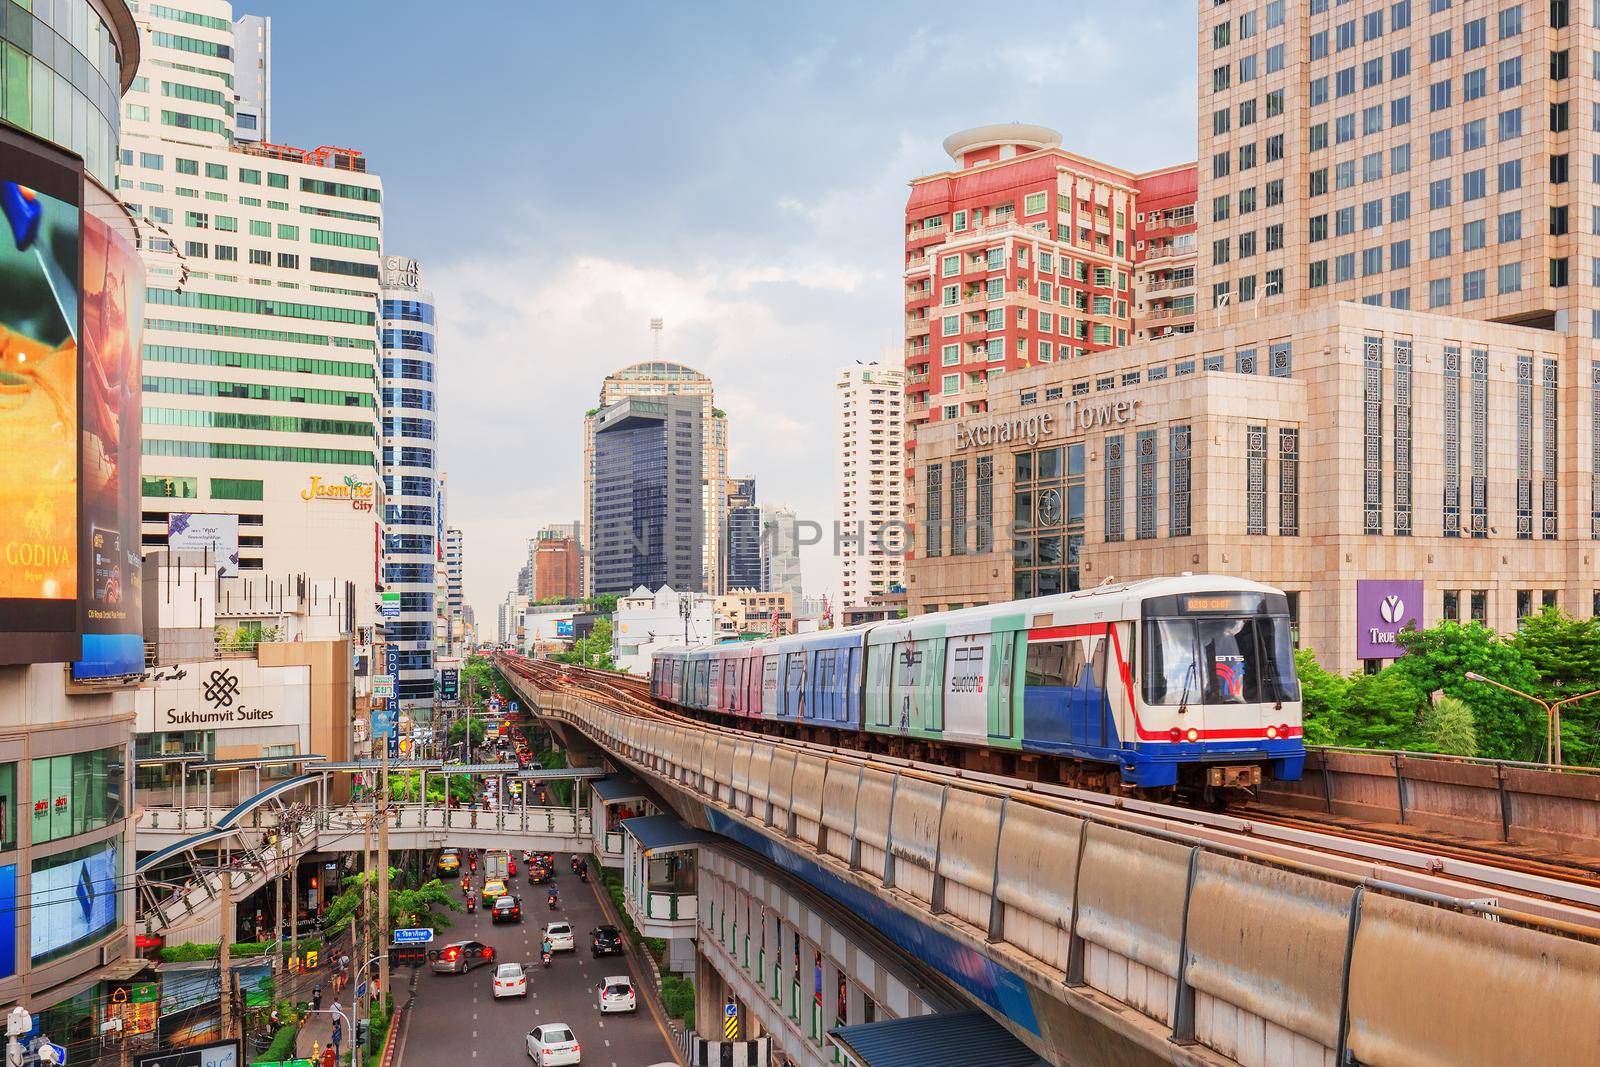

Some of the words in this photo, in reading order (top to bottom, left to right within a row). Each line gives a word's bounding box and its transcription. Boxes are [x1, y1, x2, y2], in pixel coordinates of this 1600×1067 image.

[955, 413, 1053, 451] Exchange
[1065, 398, 1143, 434] Tower
[301, 475, 373, 500] Jasmine
[352, 500, 373, 513] City
[6, 542, 70, 567] GODIVA
[952, 673, 978, 693] swatch
[167, 708, 234, 724] Sukhumvit
[237, 705, 274, 721] Suites
